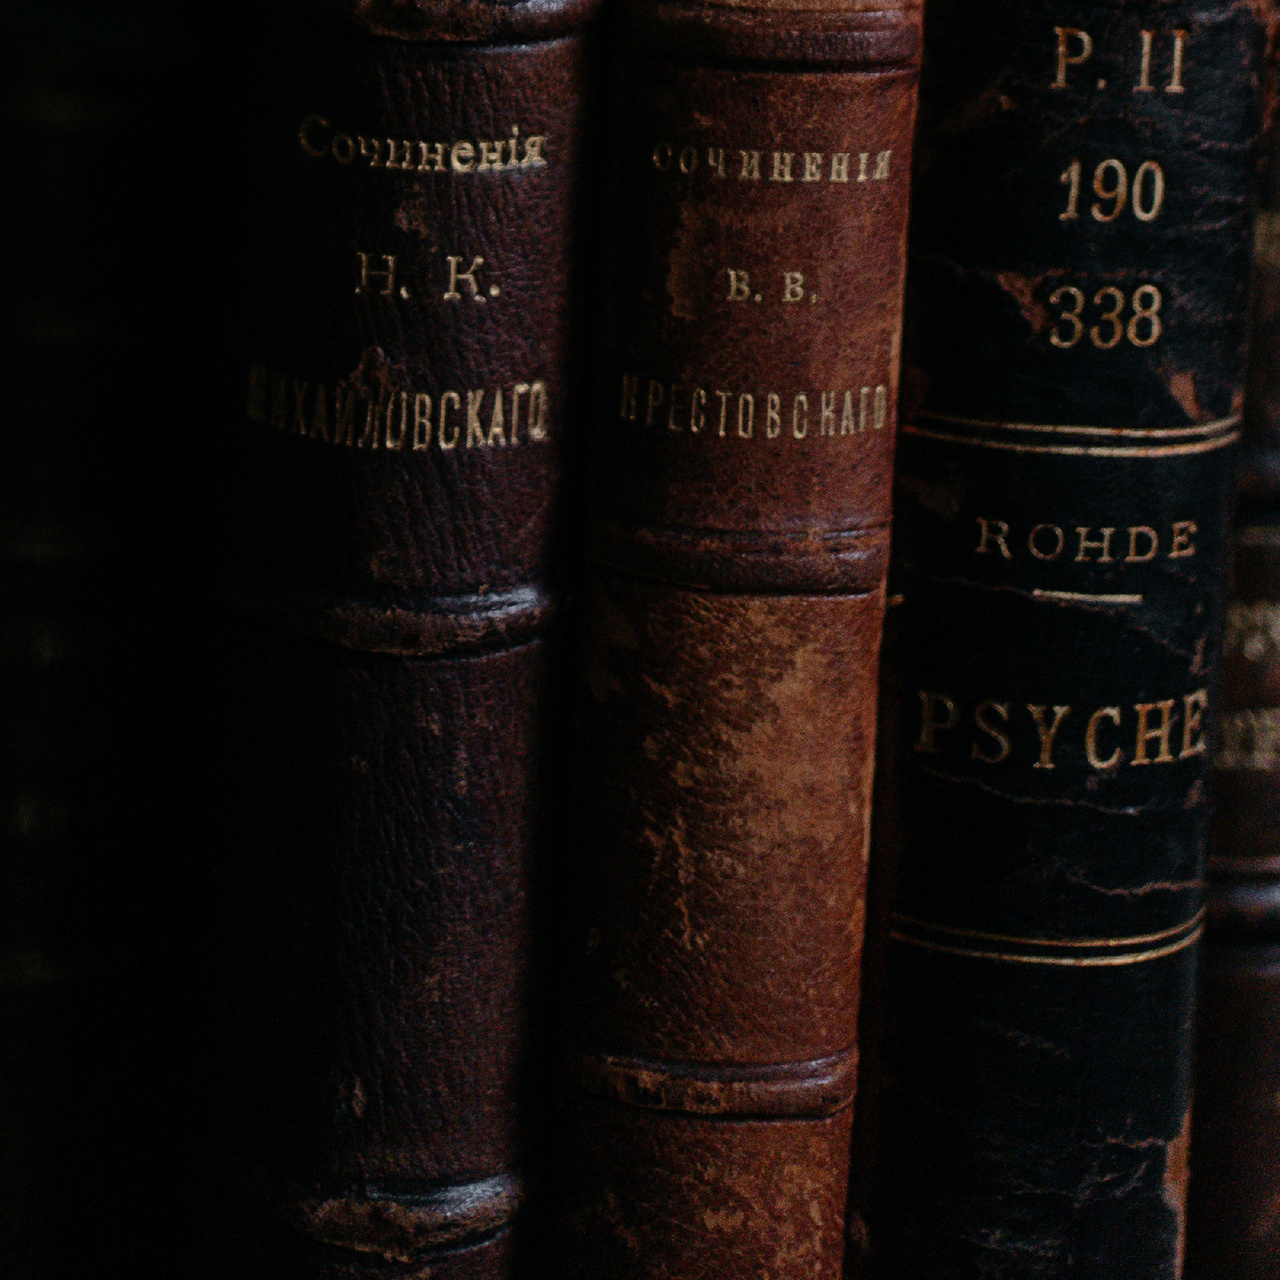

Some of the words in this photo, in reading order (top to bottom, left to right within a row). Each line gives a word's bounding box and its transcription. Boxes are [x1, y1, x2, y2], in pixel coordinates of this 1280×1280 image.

[297, 113, 549, 174] Сочиненія
[651, 141, 894, 184] СОЧИНЕНІЯ
[1058, 157, 1166, 223] 190
[1048, 283, 1164, 350] 338
[973, 516, 1200, 564] ROHDE
[913, 687, 1209, 770] PSYCHE
